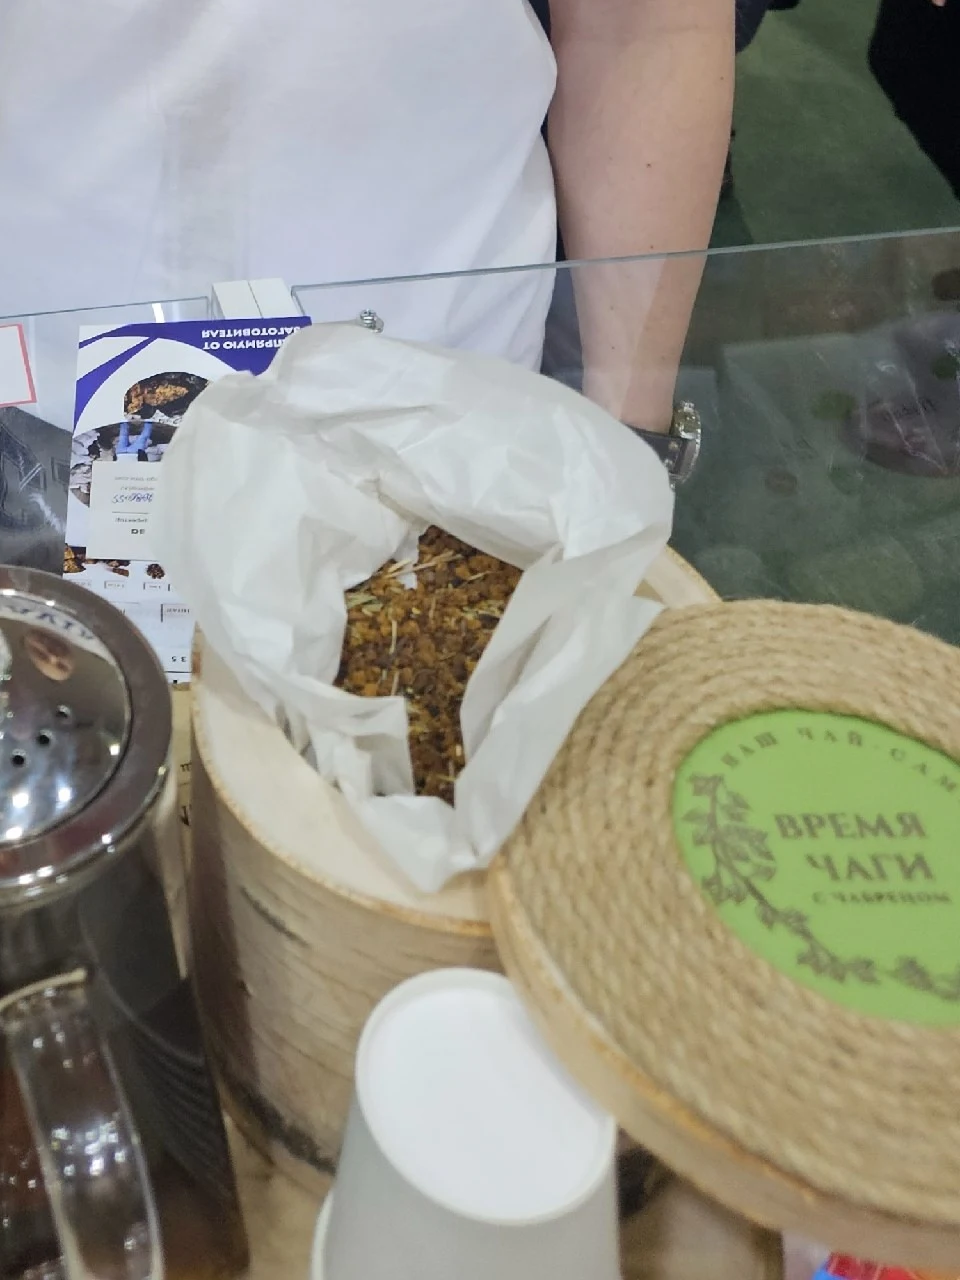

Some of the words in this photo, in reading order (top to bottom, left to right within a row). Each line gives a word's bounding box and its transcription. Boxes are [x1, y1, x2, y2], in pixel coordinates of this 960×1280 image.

[202, 341, 221, 351] ОТ
[773, 811, 928, 841] ВРЕМЯ
[804, 852, 935, 882] ЧАГИ
